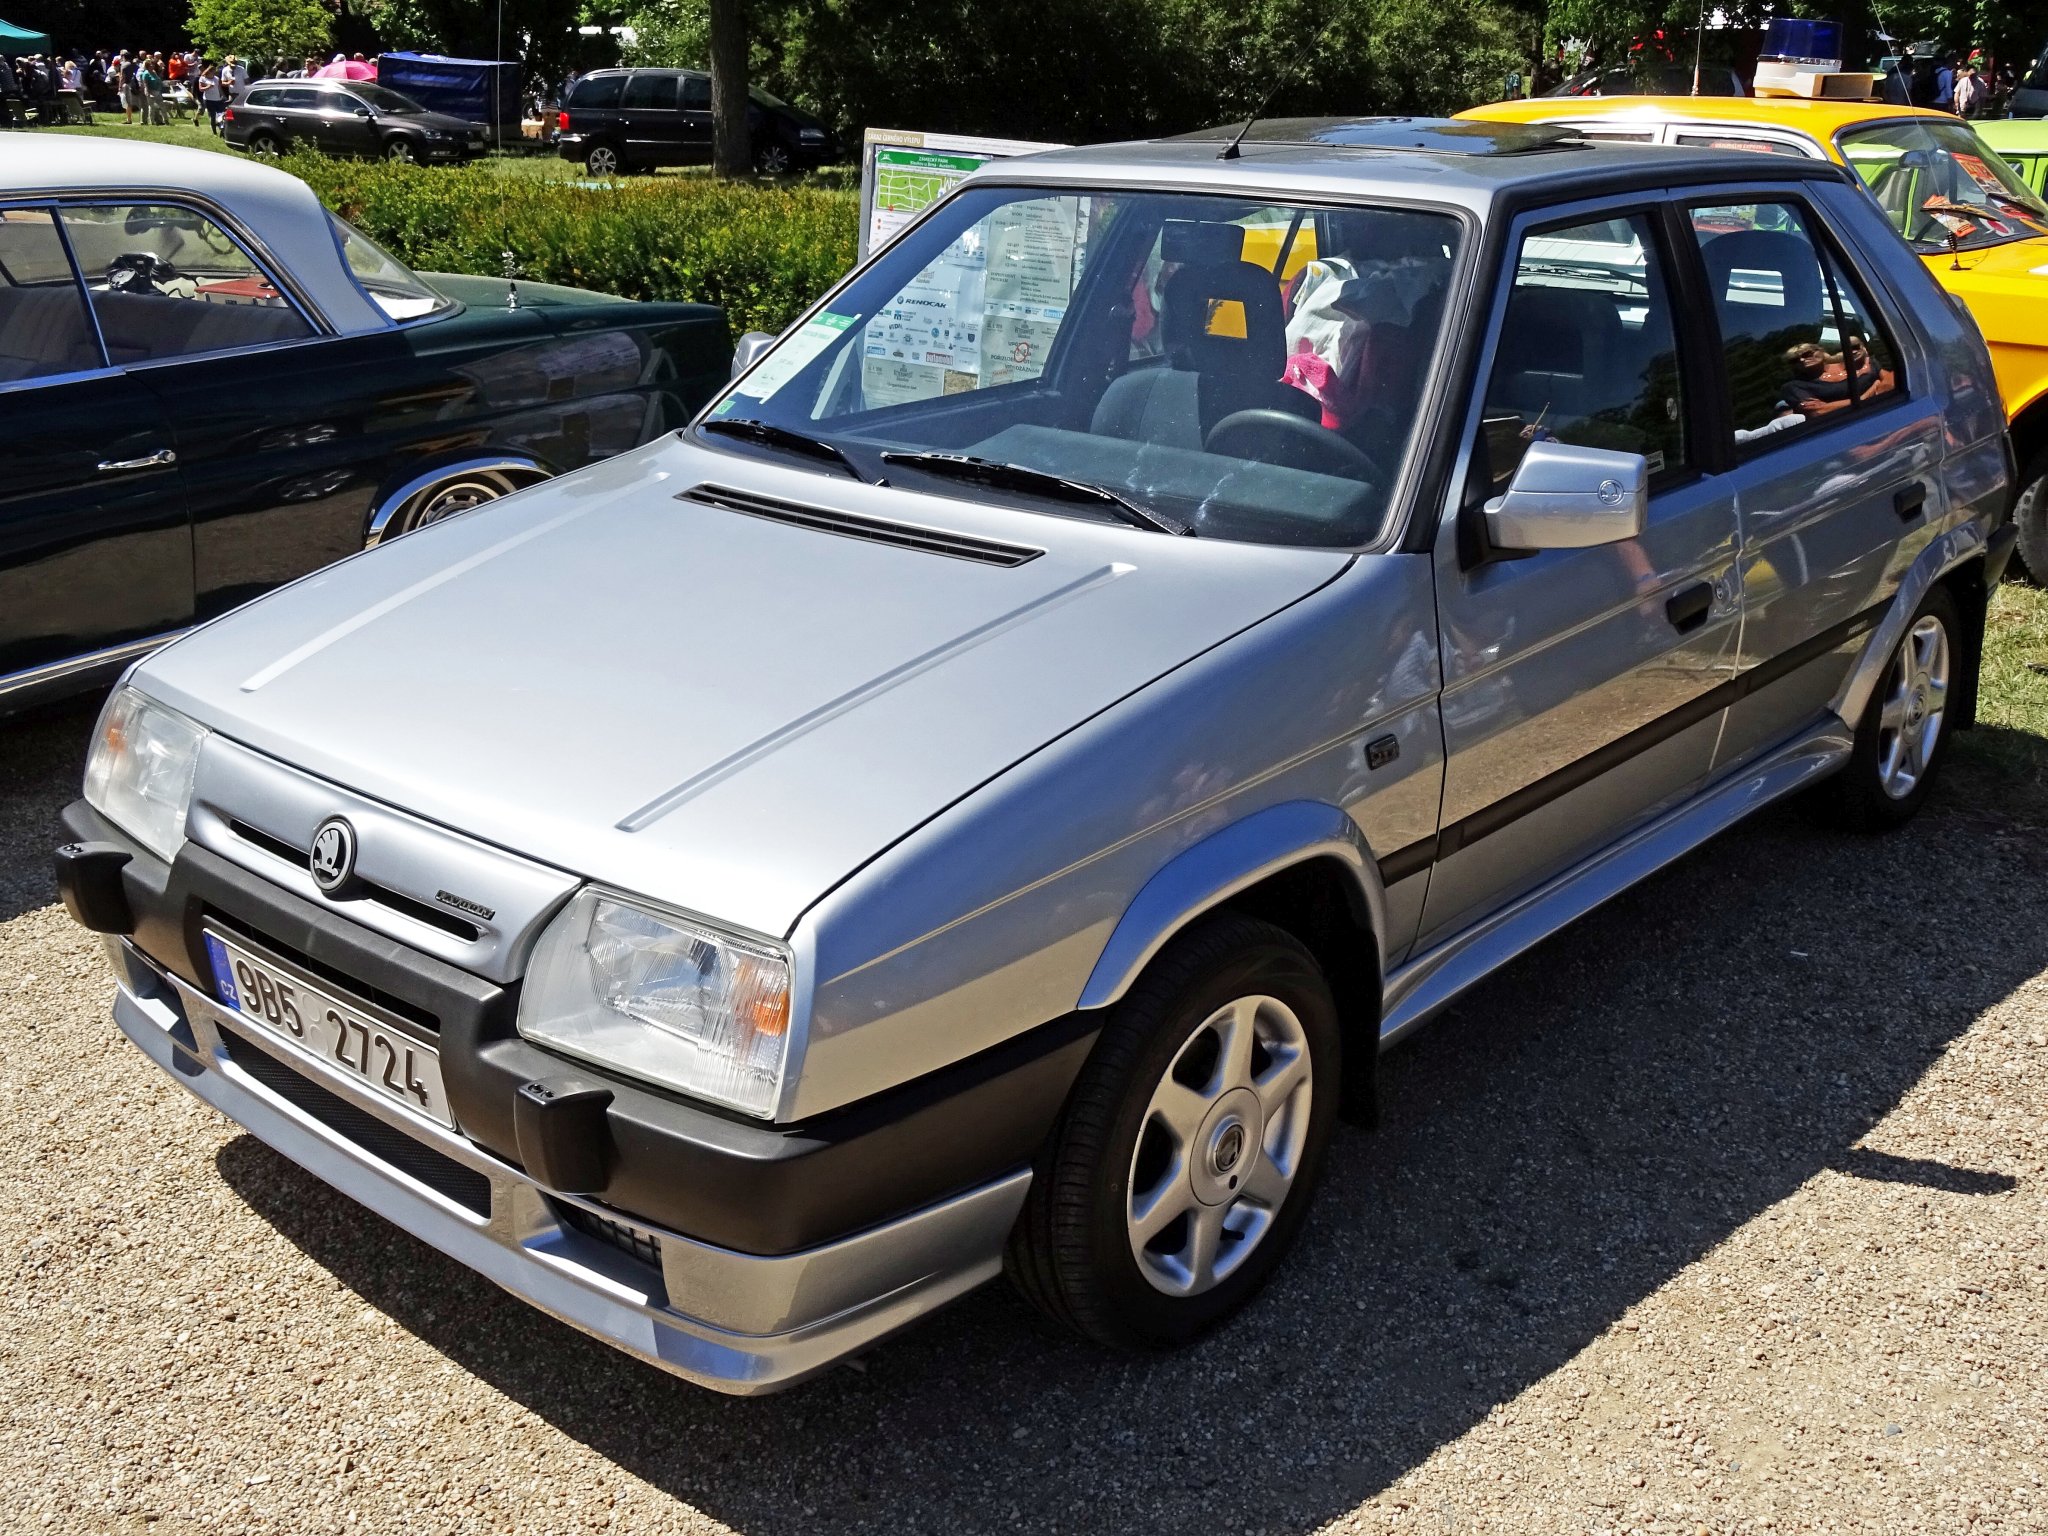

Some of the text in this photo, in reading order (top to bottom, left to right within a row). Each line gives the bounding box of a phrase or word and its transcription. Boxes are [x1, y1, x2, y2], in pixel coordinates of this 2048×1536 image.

[867, 133, 921, 144] ZÁKAZ ČERNÉHO VÝLEPU
[905, 298, 947, 308] RENOCAR
[220, 979, 237, 999] CZ
[236, 959, 428, 1106] 9B5 2724
